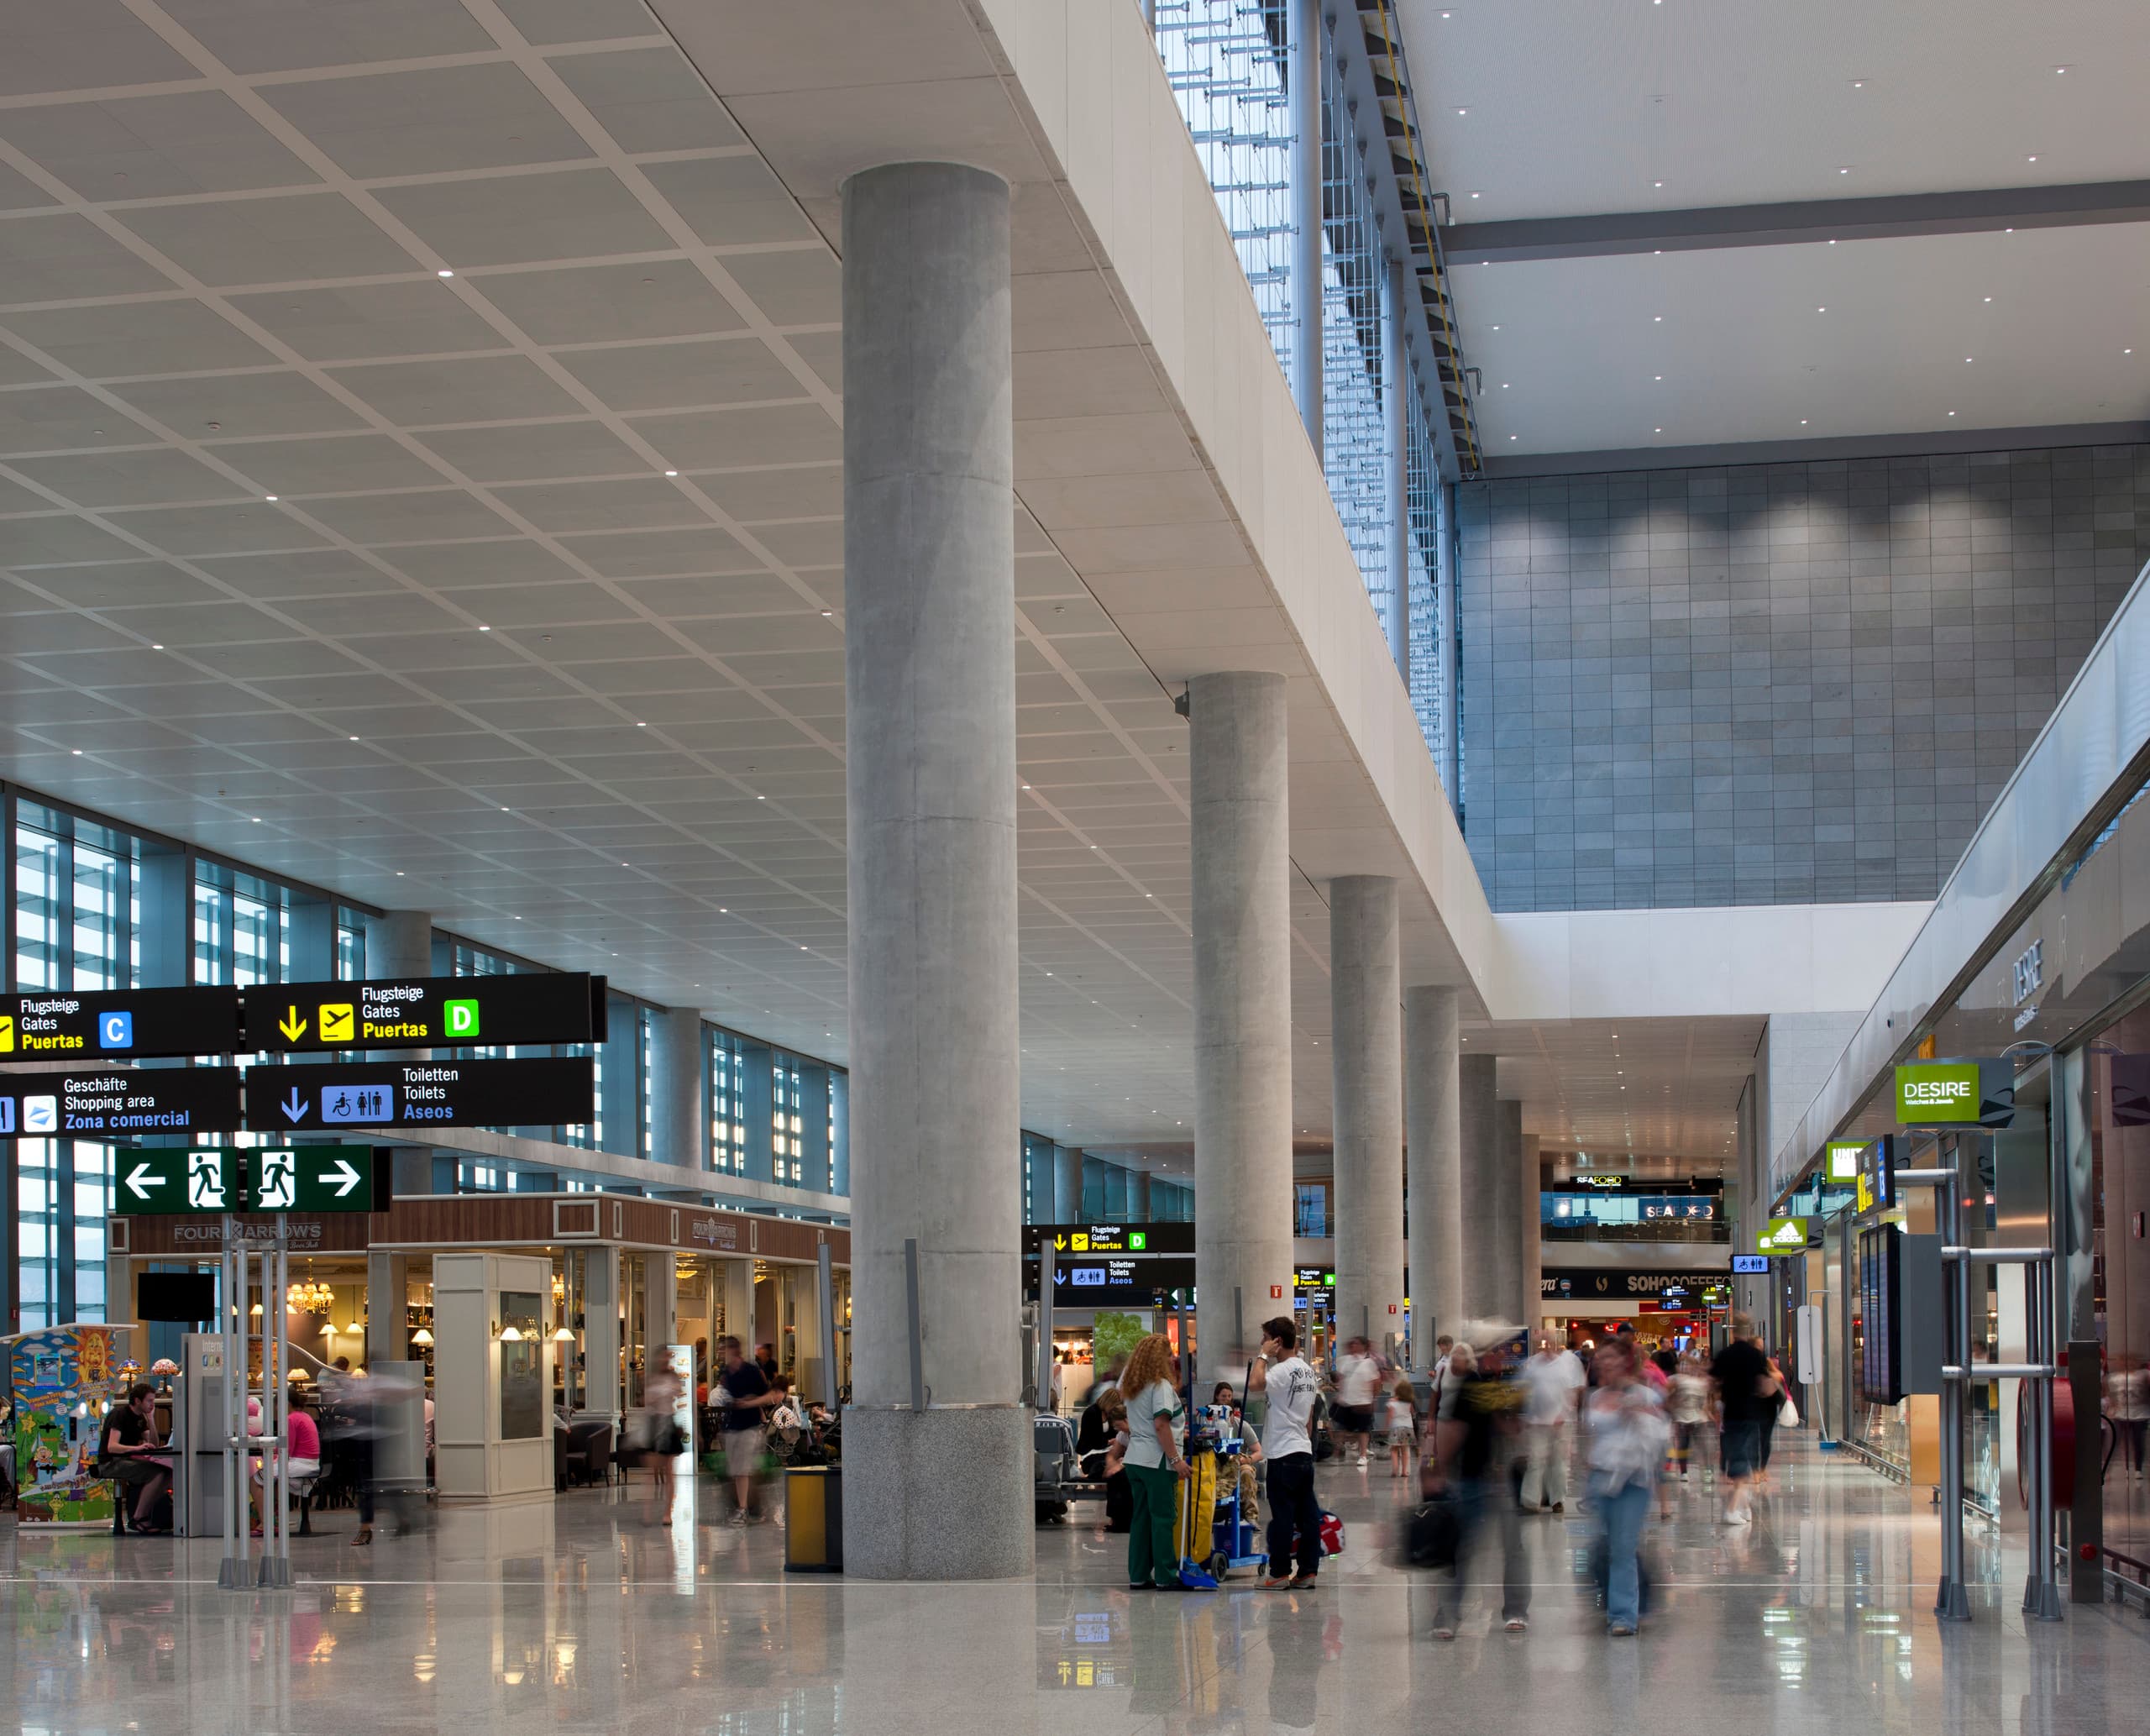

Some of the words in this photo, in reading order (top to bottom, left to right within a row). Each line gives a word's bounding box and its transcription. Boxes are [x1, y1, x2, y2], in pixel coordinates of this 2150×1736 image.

[2013, 938, 2042, 1007] DESIRE
[362, 986, 423, 1003] Flugsteige
[21, 999, 79, 1015] Flugsteige
[363, 1004, 400, 1018] Gates
[22, 1017, 57, 1031] Gates
[453, 1006, 471, 1031] D
[107, 1018, 123, 1041] C
[363, 1022, 427, 1038] Puertas
[23, 1034, 83, 1049] Puertas
[403, 1068, 458, 1082] Toiletten
[64, 1078, 127, 1093] Geschäfte
[403, 1086, 445, 1099] Toilets
[1904, 1082, 1970, 1098] DESIRE
[65, 1097, 123, 1111] Shopping
[128, 1096, 155, 1107] area
[66, 1114, 103, 1129] Zona
[110, 1110, 190, 1126] comercial
[404, 1104, 454, 1120] Aseos
[1576, 1177, 1622, 1185] SEAFOOD
[174, 1227, 222, 1240] FOUR
[1133, 1235, 1142, 1247] D
